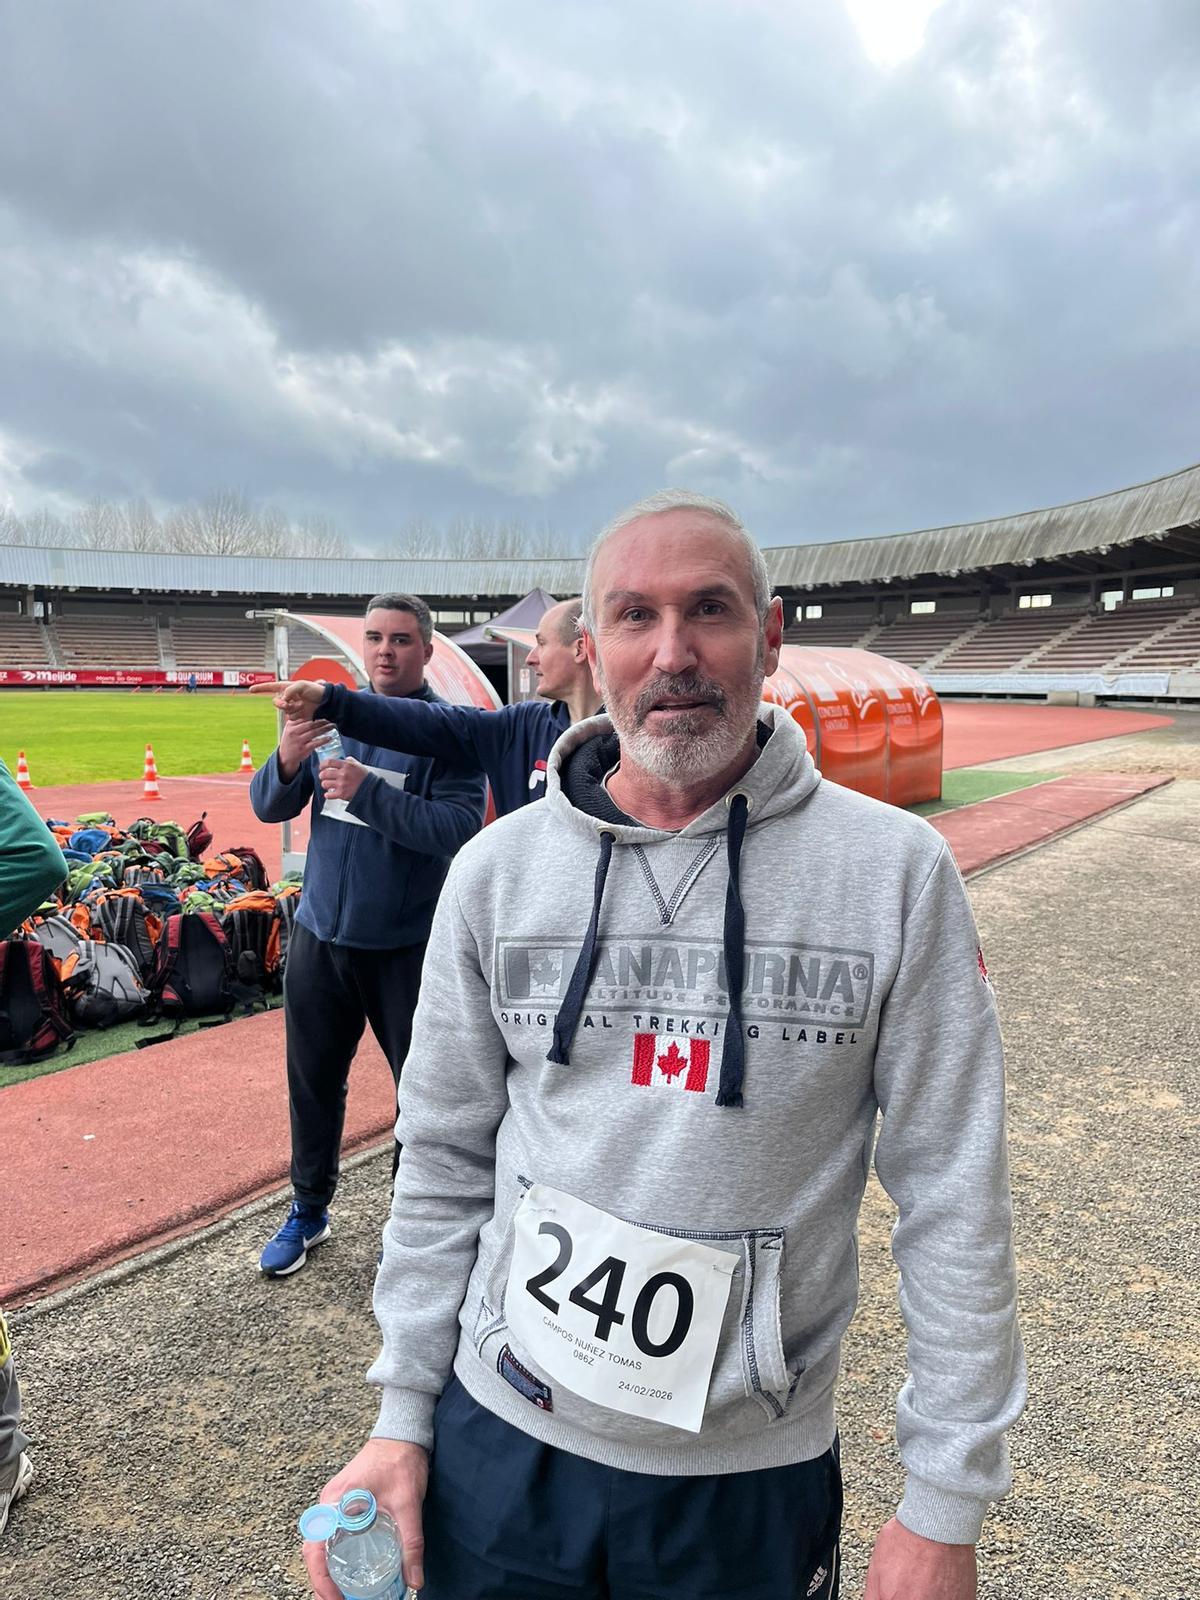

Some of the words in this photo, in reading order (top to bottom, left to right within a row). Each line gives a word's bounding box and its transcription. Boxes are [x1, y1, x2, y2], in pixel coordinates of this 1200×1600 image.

[703, 993, 854, 1016] PEFORMANCE
[633, 1015, 759, 1039] TREKKIG
[782, 1028, 857, 1044] LABEL
[525, 1221, 694, 1358] 240
[543, 1316, 573, 1342] CAMPOS
[575, 1338, 606, 1359] NUÑEZ
[608, 1352, 642, 1370] TOMAS
[573, 1349, 595, 1366] 086Z
[618, 1380, 673, 1401] 24/02/2026
